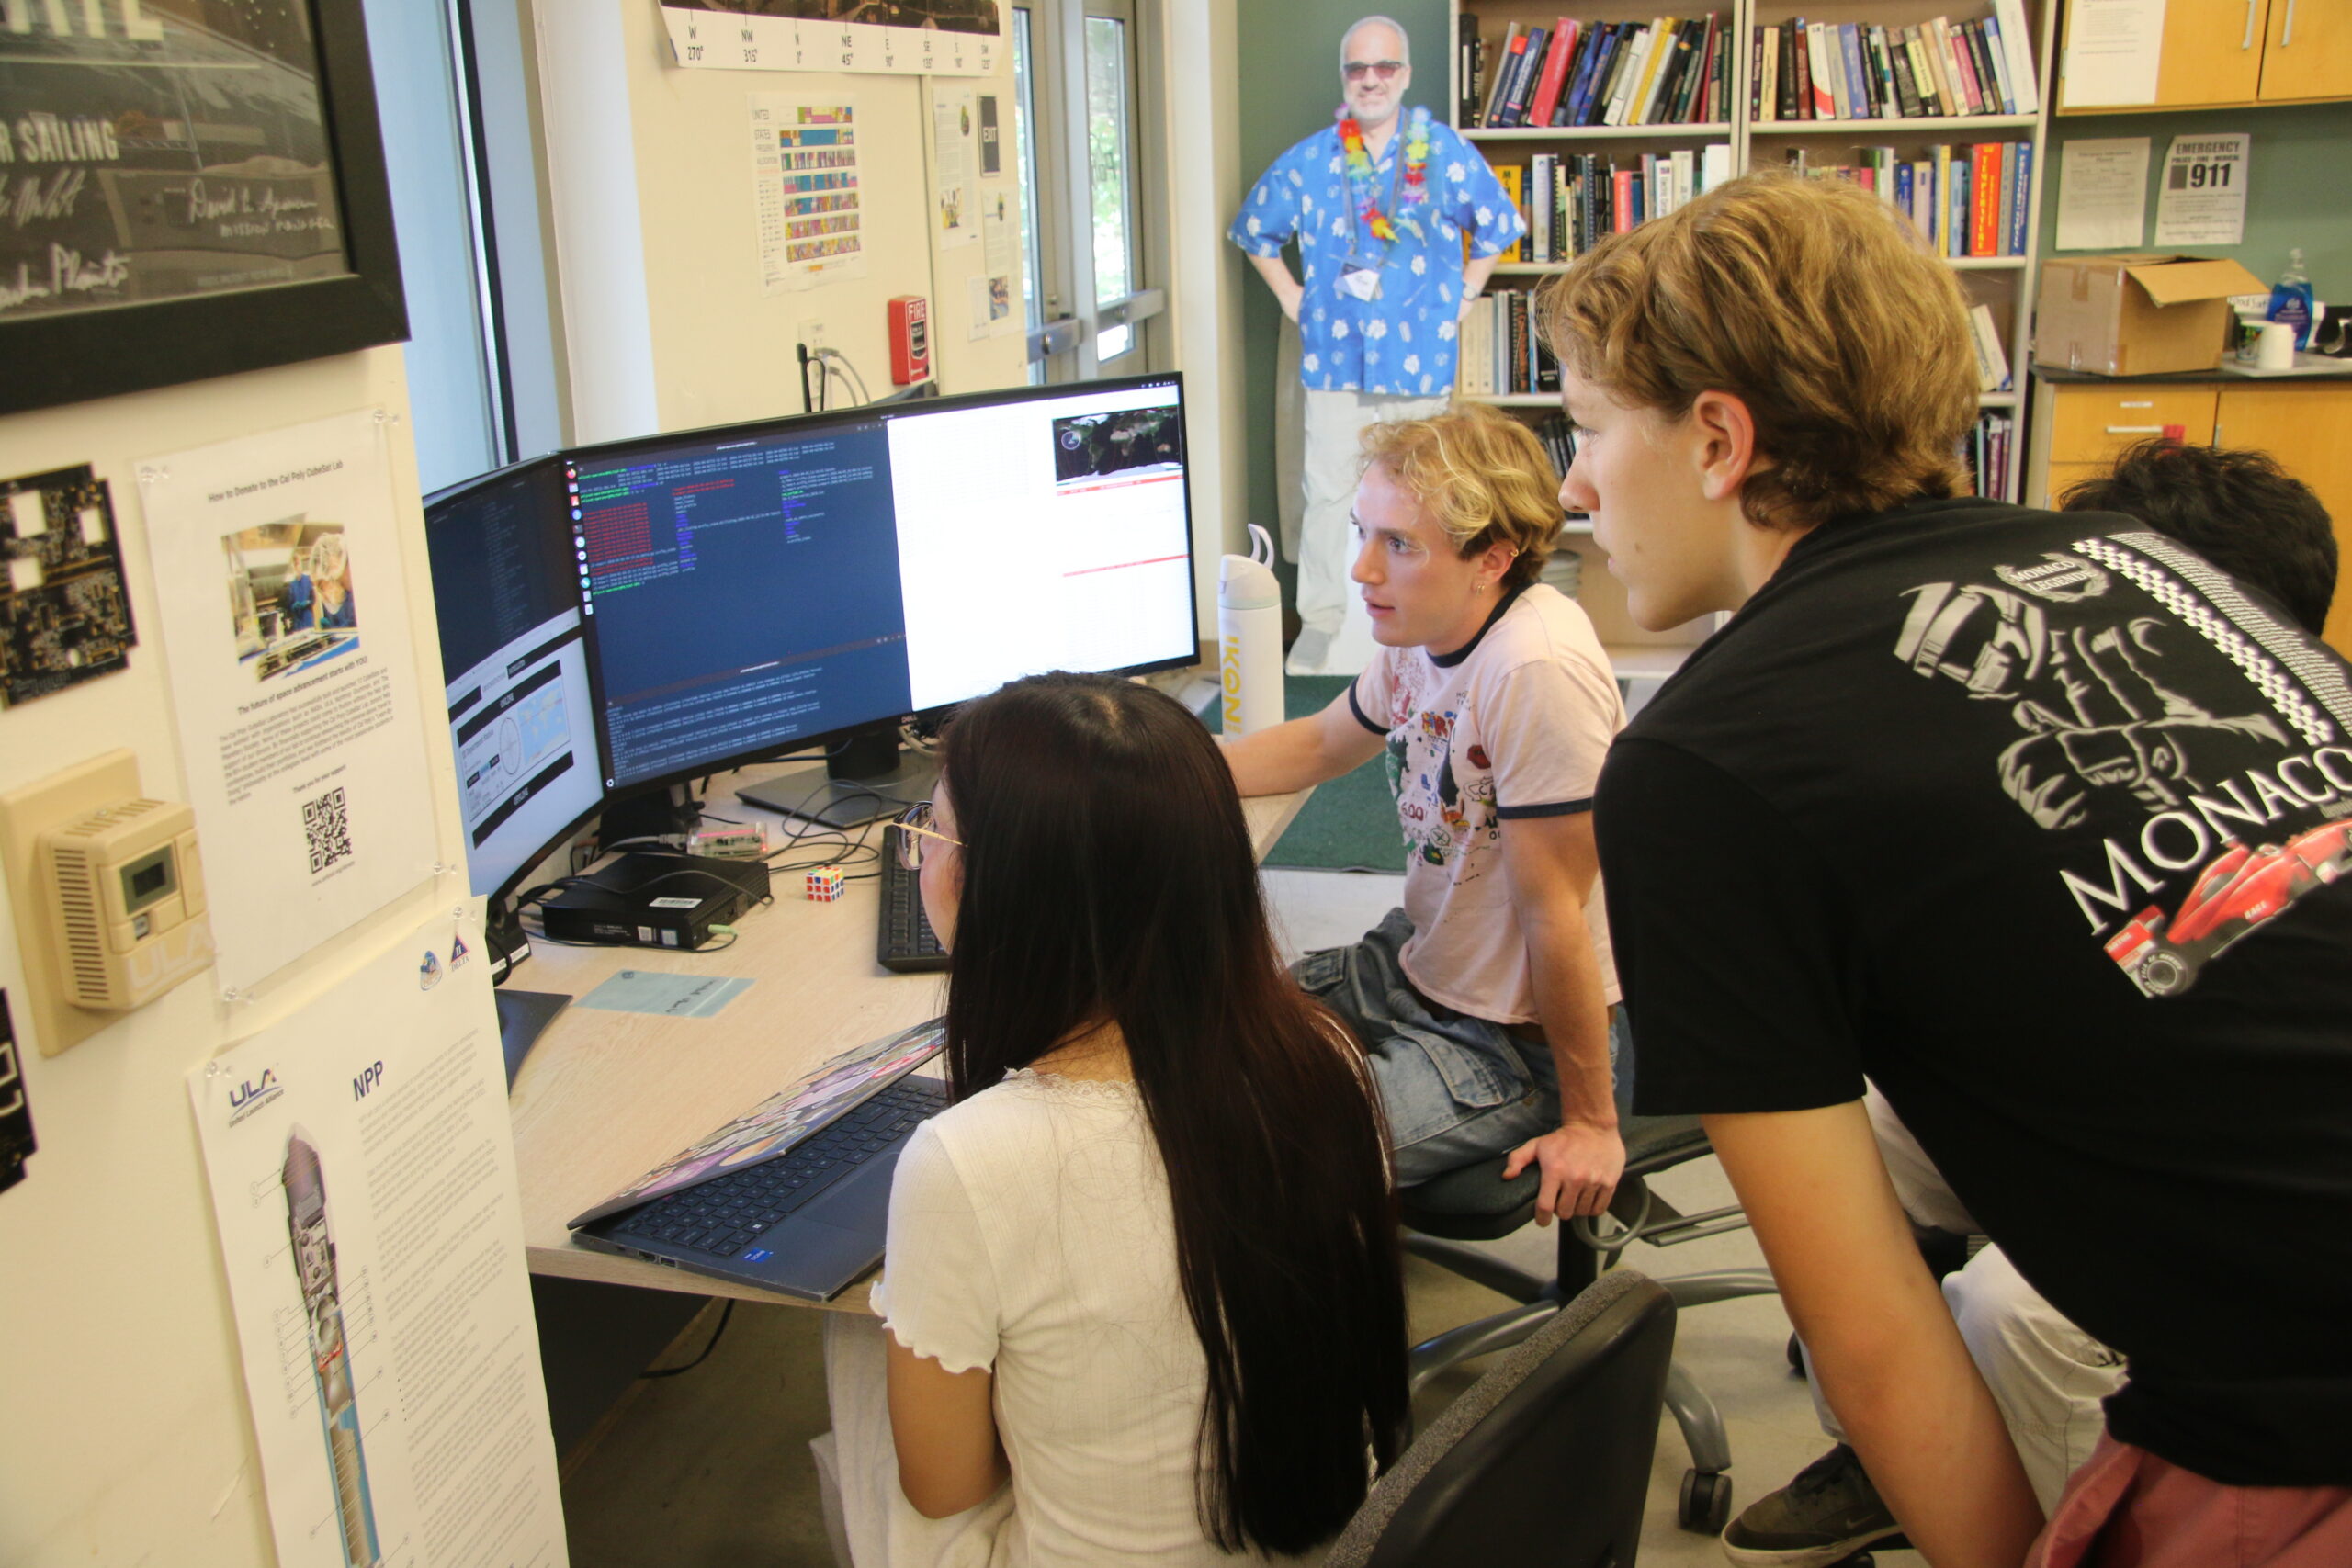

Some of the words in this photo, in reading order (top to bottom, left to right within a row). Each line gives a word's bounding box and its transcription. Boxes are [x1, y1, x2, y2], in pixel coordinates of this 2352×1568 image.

[688, 26, 696, 39] W
[741, 30, 753, 42] NW
[842, 36, 852, 47] NE
[842, 53, 853, 66] 45°
[17, 117, 119, 163] SAILING
[2176, 141, 2240, 154] EMERGENCY
[2190, 163, 2231, 188] 911
[909, 300, 925, 321] FIRE
[208, 491, 224, 502] How
[226, 490, 233, 499] to
[234, 484, 258, 497] Donate
[259, 481, 267, 490] to
[267, 478, 278, 488] the
[279, 474, 290, 484] Cal
[291, 470, 305, 481] Poly
[306, 463, 332, 478] CubeSat
[333, 459, 344, 470] Lab
[2010, 560, 2076, 582] MONACO
[1223, 636, 1241, 724] IKON
[901, 714, 918, 724] DELL
[451, 956, 469, 972] DELTA
[229, 1068, 277, 1107] ULA
[353, 1060, 383, 1102] NPP
